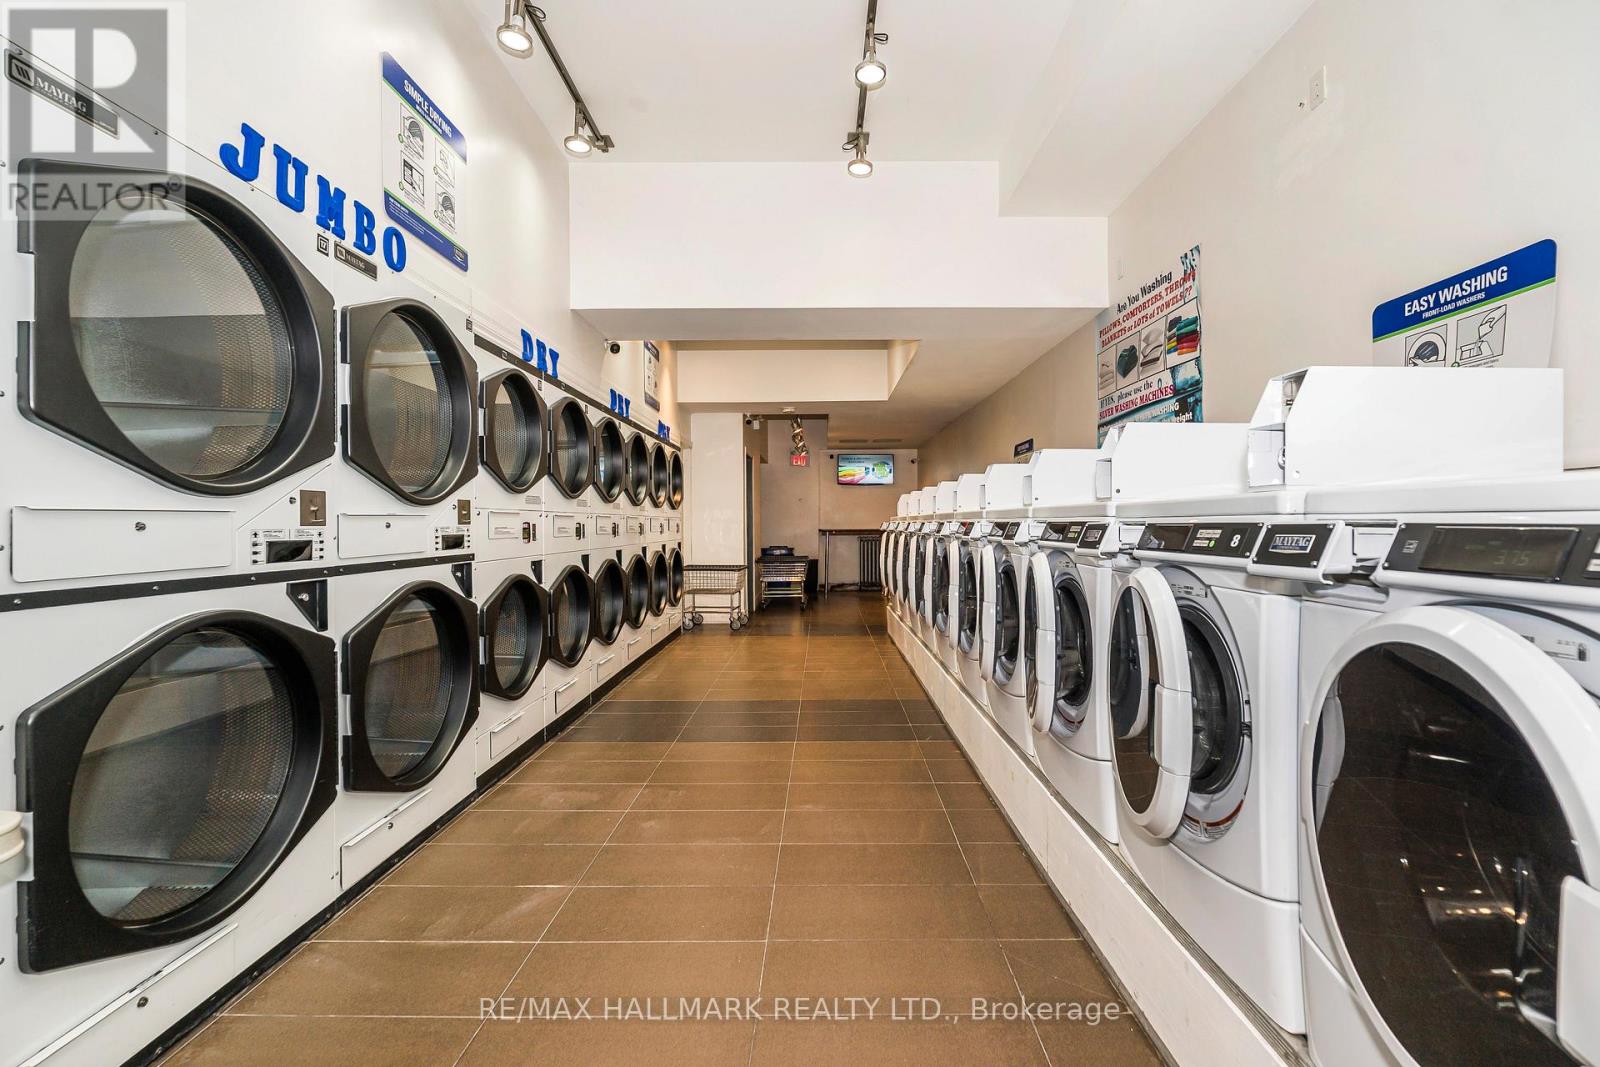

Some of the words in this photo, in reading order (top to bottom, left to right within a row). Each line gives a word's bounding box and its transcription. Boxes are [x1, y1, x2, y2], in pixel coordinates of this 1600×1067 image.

[36, 77, 87, 113] MAYTAG
[404, 80, 429, 114] SIMPLE
[429, 106, 452, 138] DRYING
[219, 122, 407, 273] JUMBO
[1117, 302, 1128, 314] Are
[1127, 293, 1139, 307] You
[1140, 271, 1172, 298] Washing
[1404, 292, 1437, 317] EASY
[1438, 266, 1508, 302] WASHING
[1422, 302, 1456, 319] FRONT-LOAD
[1456, 291, 1486, 308] WASHERS
[1133, 313, 1149, 329] LOTS
[521, 328, 559, 379] DRY
[609, 388, 631, 419] DRY
[1099, 406, 1114, 420] SILVER
[1115, 397, 1139, 413] WASHING
[1139, 384, 1175, 404] MACHINES
[1117, 389, 1133, 404] please
[1134, 385, 1143, 395] use
[1143, 380, 1153, 391] the
[1229, 534, 1241, 547] 8
[1274, 536, 1311, 546] MAYTAG
